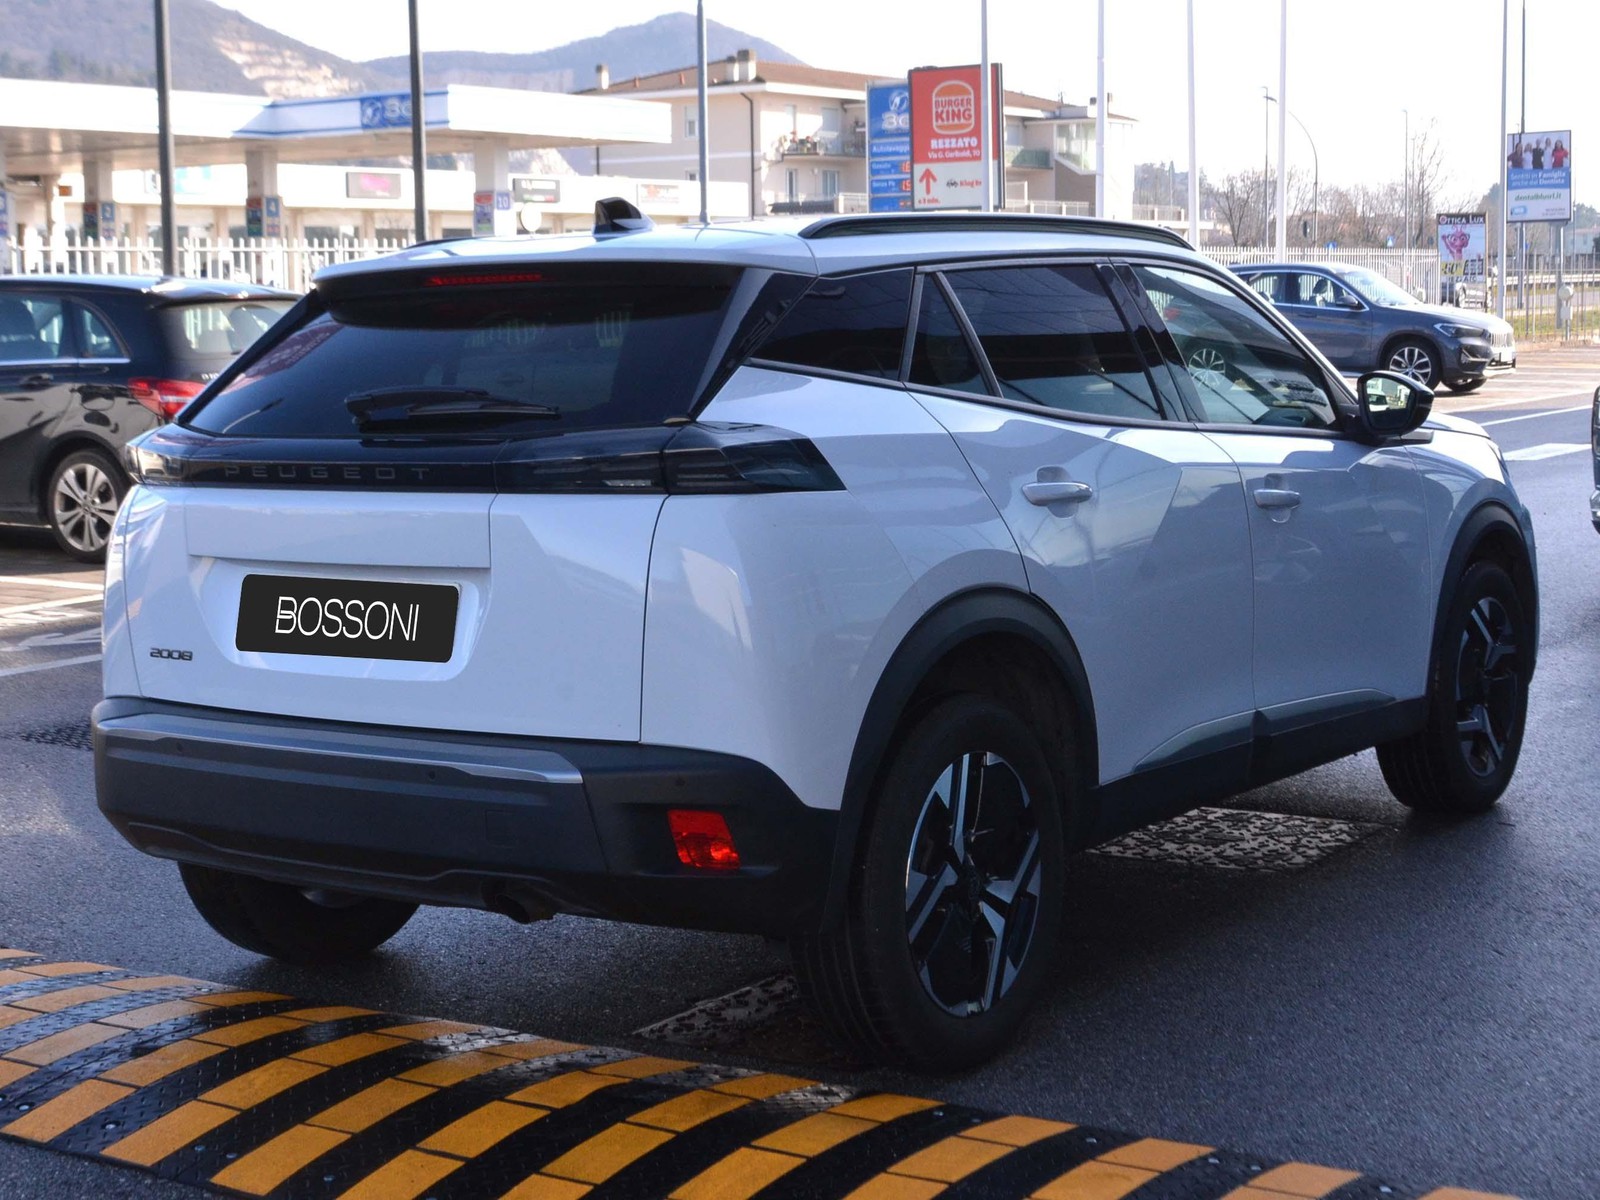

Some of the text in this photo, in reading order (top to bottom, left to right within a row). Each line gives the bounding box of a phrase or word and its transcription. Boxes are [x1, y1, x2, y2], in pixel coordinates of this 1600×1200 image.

[935, 98, 972, 109] BURGER
[935, 109, 972, 122] KING
[931, 137, 978, 149] REZZATO
[928, 151, 938, 159] Via
[498, 195, 508, 208] 10
[224, 464, 430, 480] PEUGEOT
[149, 647, 193, 661] 2008
